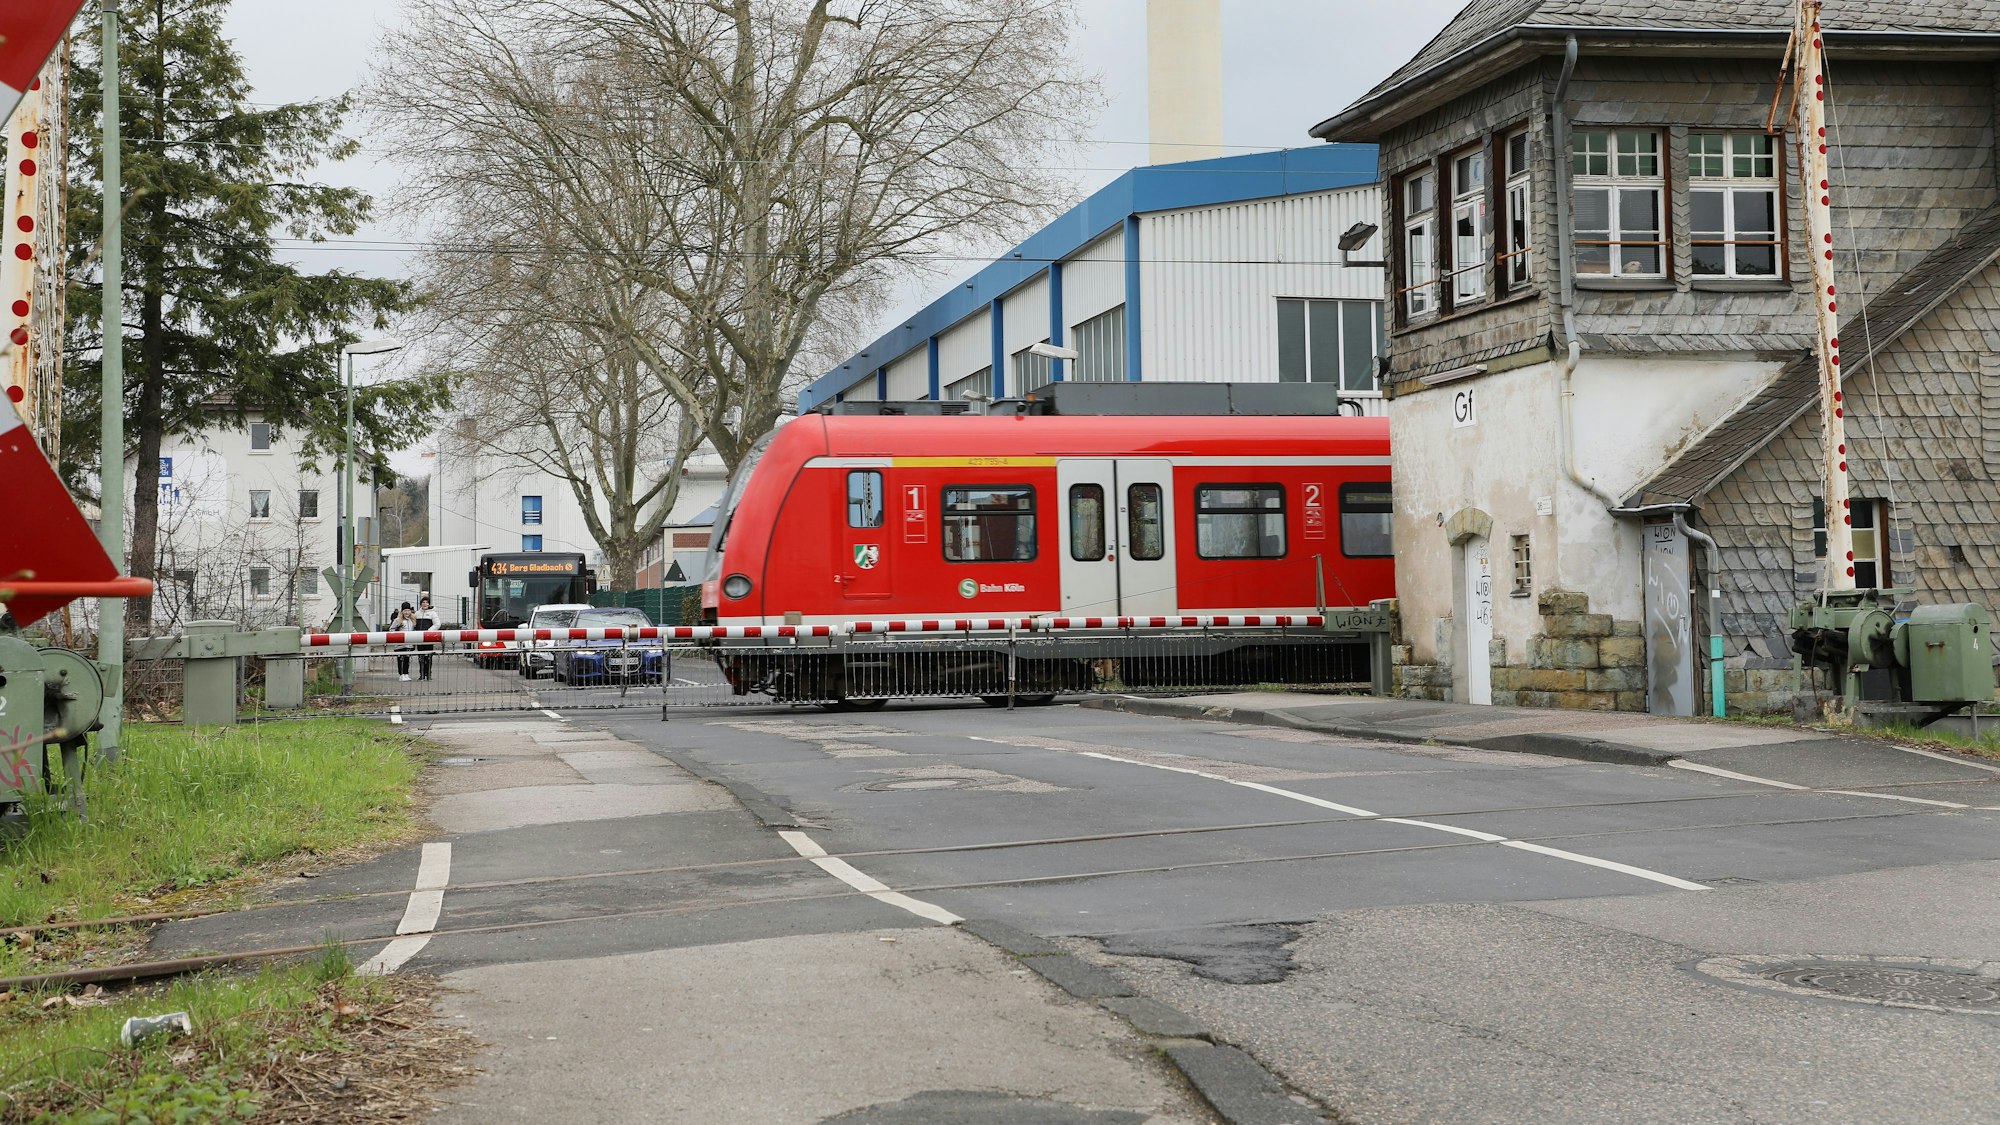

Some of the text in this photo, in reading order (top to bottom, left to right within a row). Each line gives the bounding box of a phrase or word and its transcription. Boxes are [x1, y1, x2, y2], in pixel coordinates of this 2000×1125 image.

[1454, 389, 1473, 422] Gf
[907, 487, 919, 509] 1
[1305, 485, 1320, 507] 2
[491, 562, 507, 575] 434
[509, 563, 528, 573] Berg
[529, 563, 563, 572] Gladbach
[834, 575, 841, 583] 2
[961, 580, 1025, 597] S Bahn Köln
[1973, 638, 1979, 651] 4
